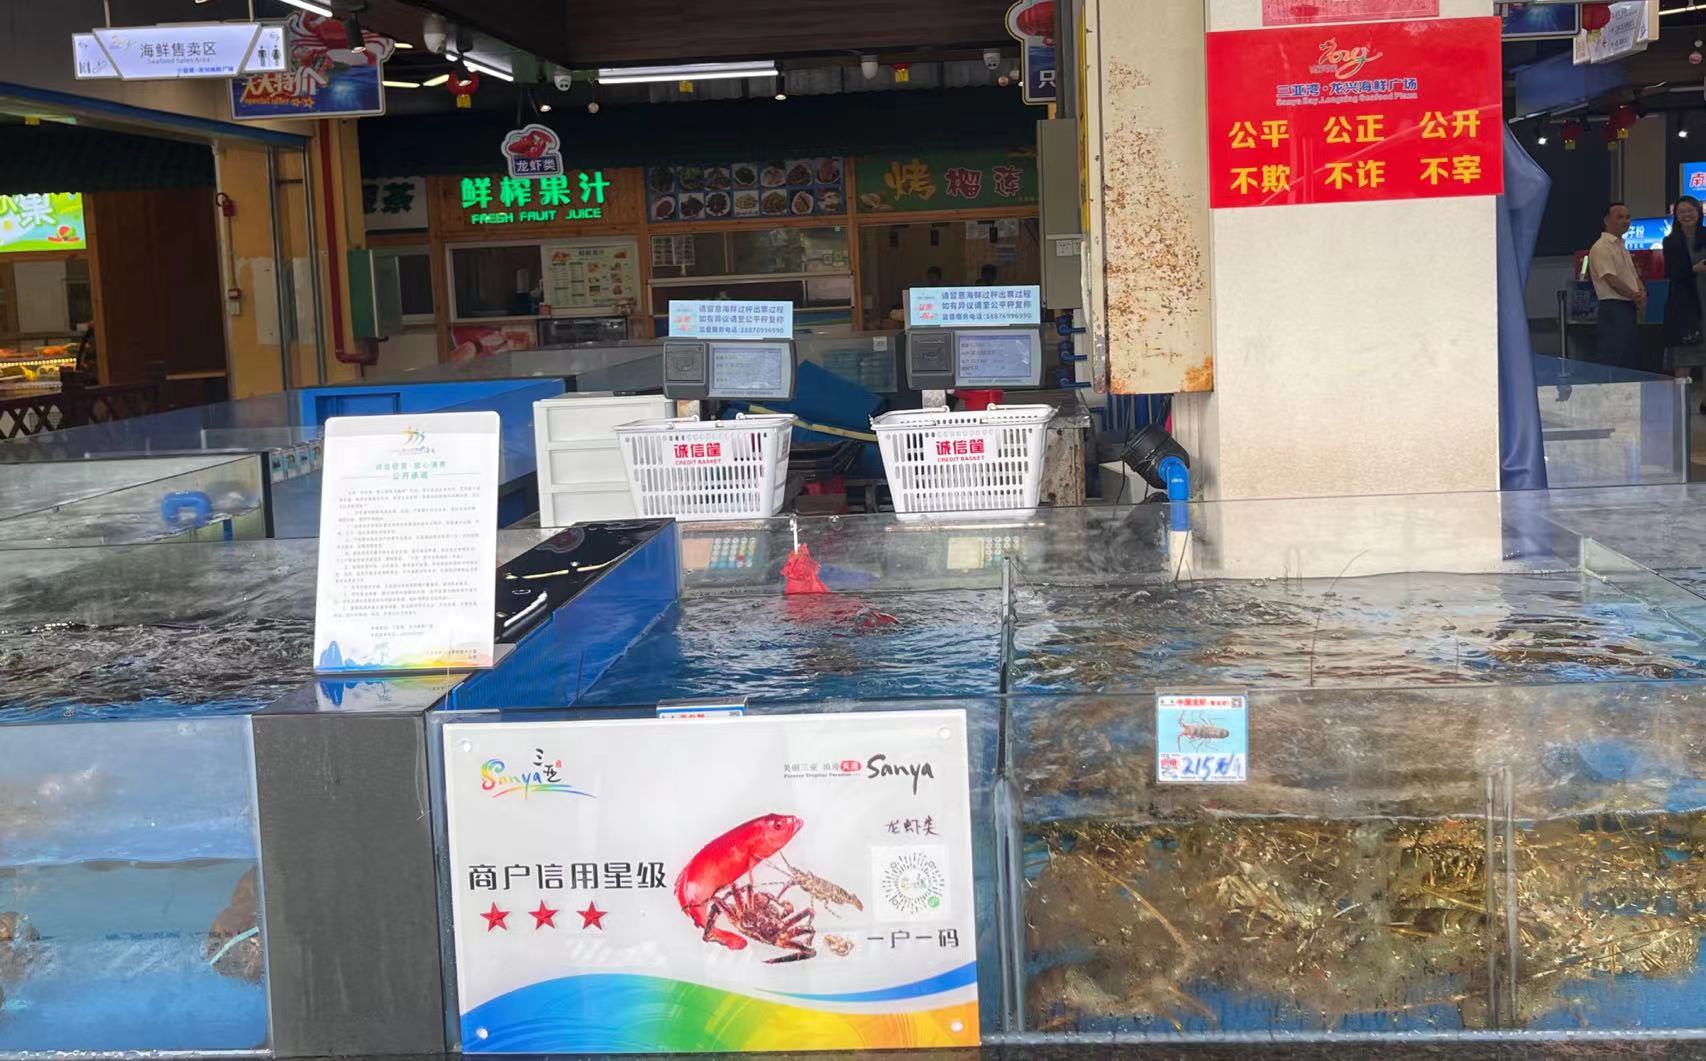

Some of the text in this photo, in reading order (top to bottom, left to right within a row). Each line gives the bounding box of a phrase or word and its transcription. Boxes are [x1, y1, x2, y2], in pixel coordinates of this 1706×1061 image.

[140, 42, 217, 58] 海鲜售卖区
[1228, 110, 1481, 149] 公平 公正 公开
[516, 159, 556, 172] 龙虾类
[1230, 155, 1481, 194] 不欺 不诈 不宰
[461, 172, 610, 208] 鲜榨果汁
[471, 208, 602, 224] FRESH FRUIT JUICE
[481, 758, 542, 800] Sanya
[866, 754, 934, 795] Sanya
[468, 861, 667, 890] 商户信用星级
[866, 928, 959, 949] 一户一码
